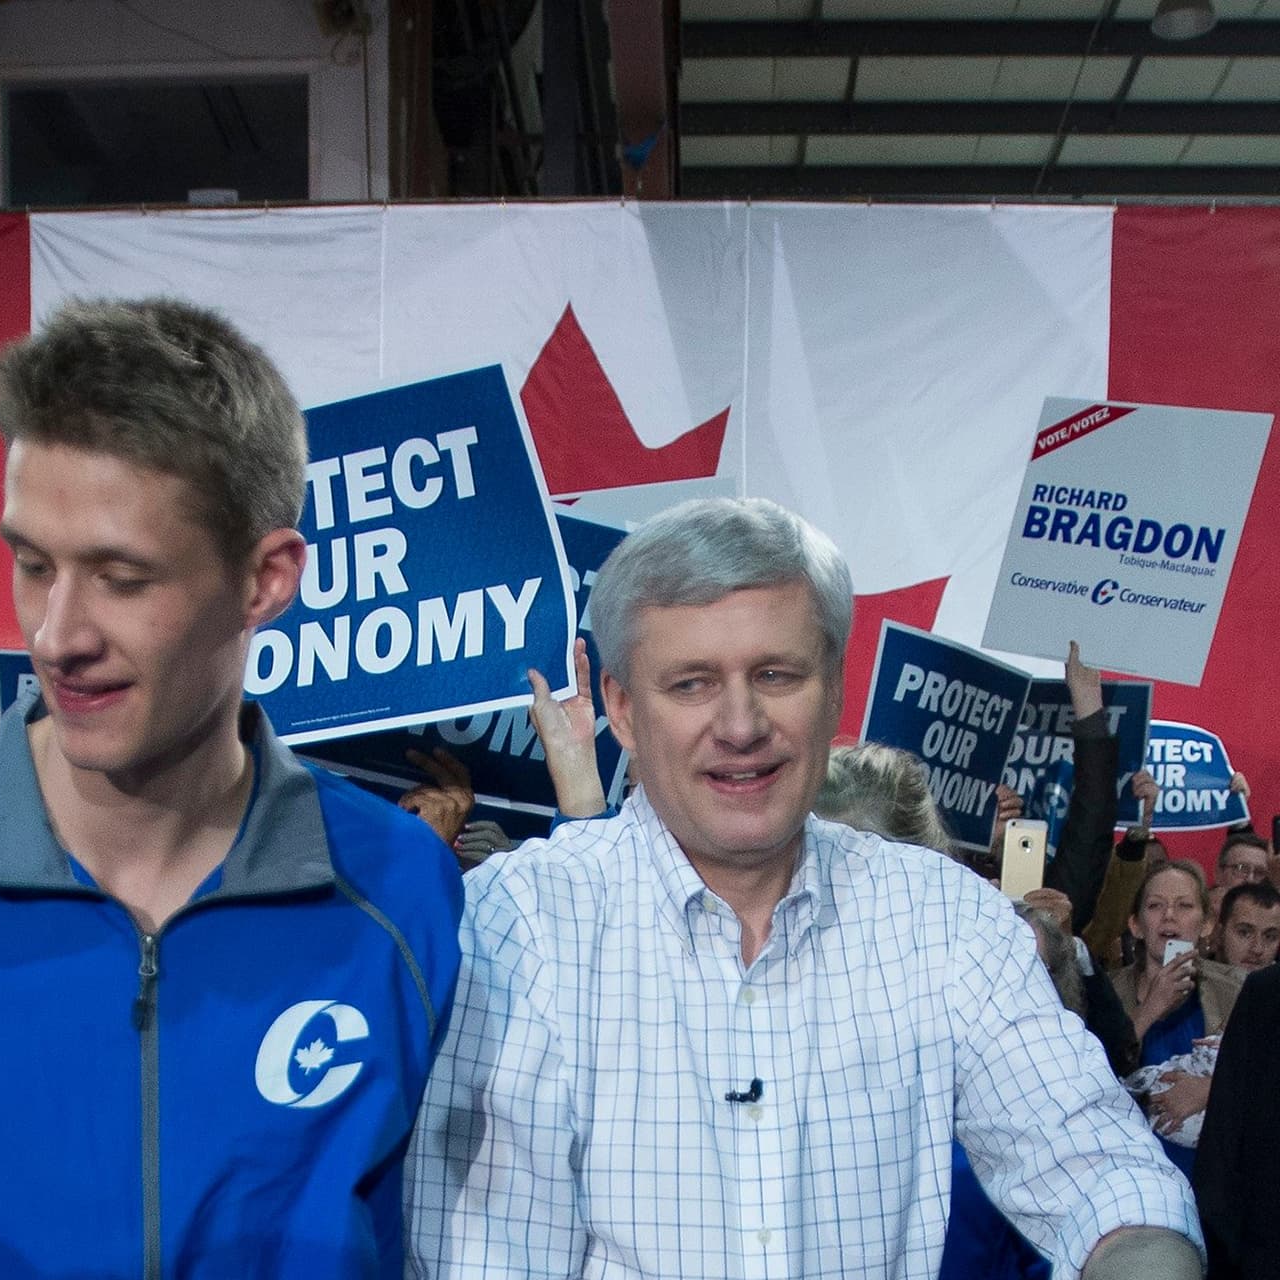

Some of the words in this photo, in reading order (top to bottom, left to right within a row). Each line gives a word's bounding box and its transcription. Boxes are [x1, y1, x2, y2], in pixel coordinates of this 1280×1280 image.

[1037, 405, 1111, 449] VOTE/VOTEZ
[1032, 484, 1128, 511] RICHARD
[1022, 505, 1225, 563] BRAGDON
[1011, 572, 1089, 596] Conservative
[1119, 588, 1207, 613] Conservateur
[893, 662, 1013, 735] PROTECT
[922, 720, 978, 769] OUR
[1146, 738, 1213, 763] TECT
